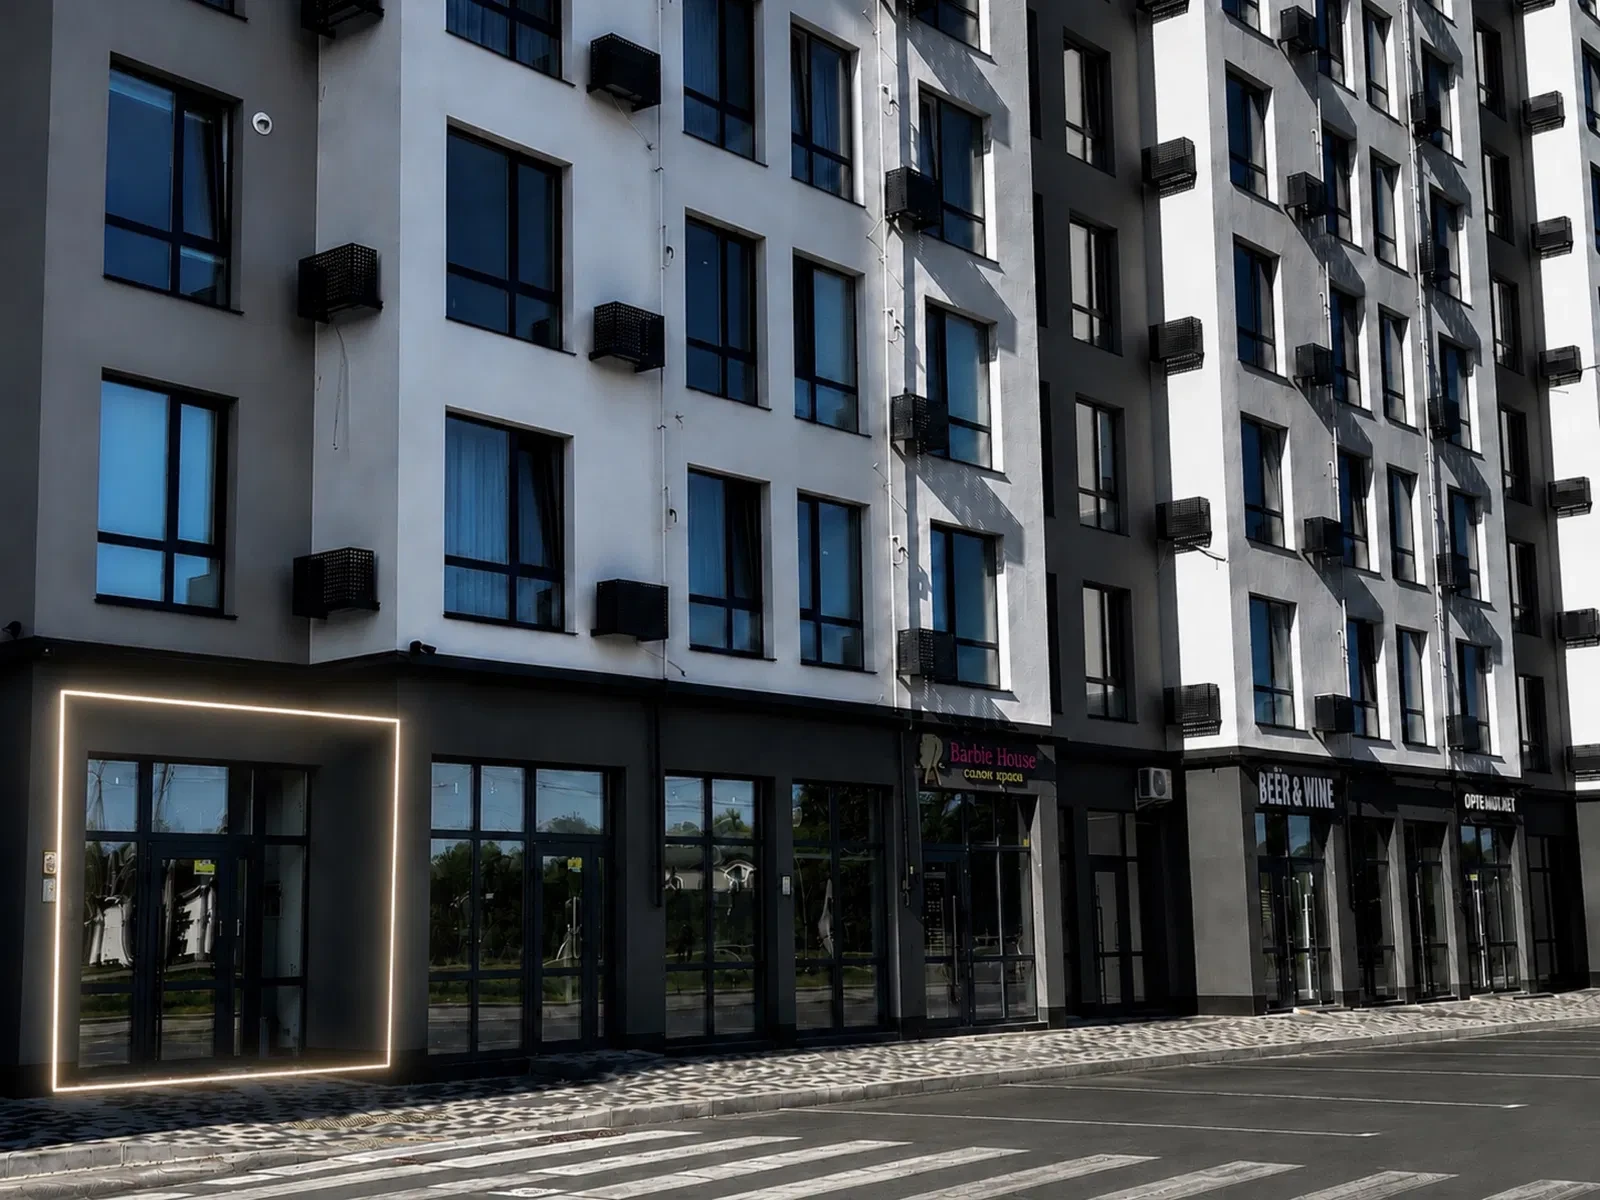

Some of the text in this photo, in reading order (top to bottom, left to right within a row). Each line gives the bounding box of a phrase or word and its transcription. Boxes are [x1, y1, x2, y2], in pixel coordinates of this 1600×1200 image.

[950, 742, 1037, 769] Barbie House
[1292, 776, 1303, 807] &
[1303, 776, 1336, 809] WINE
